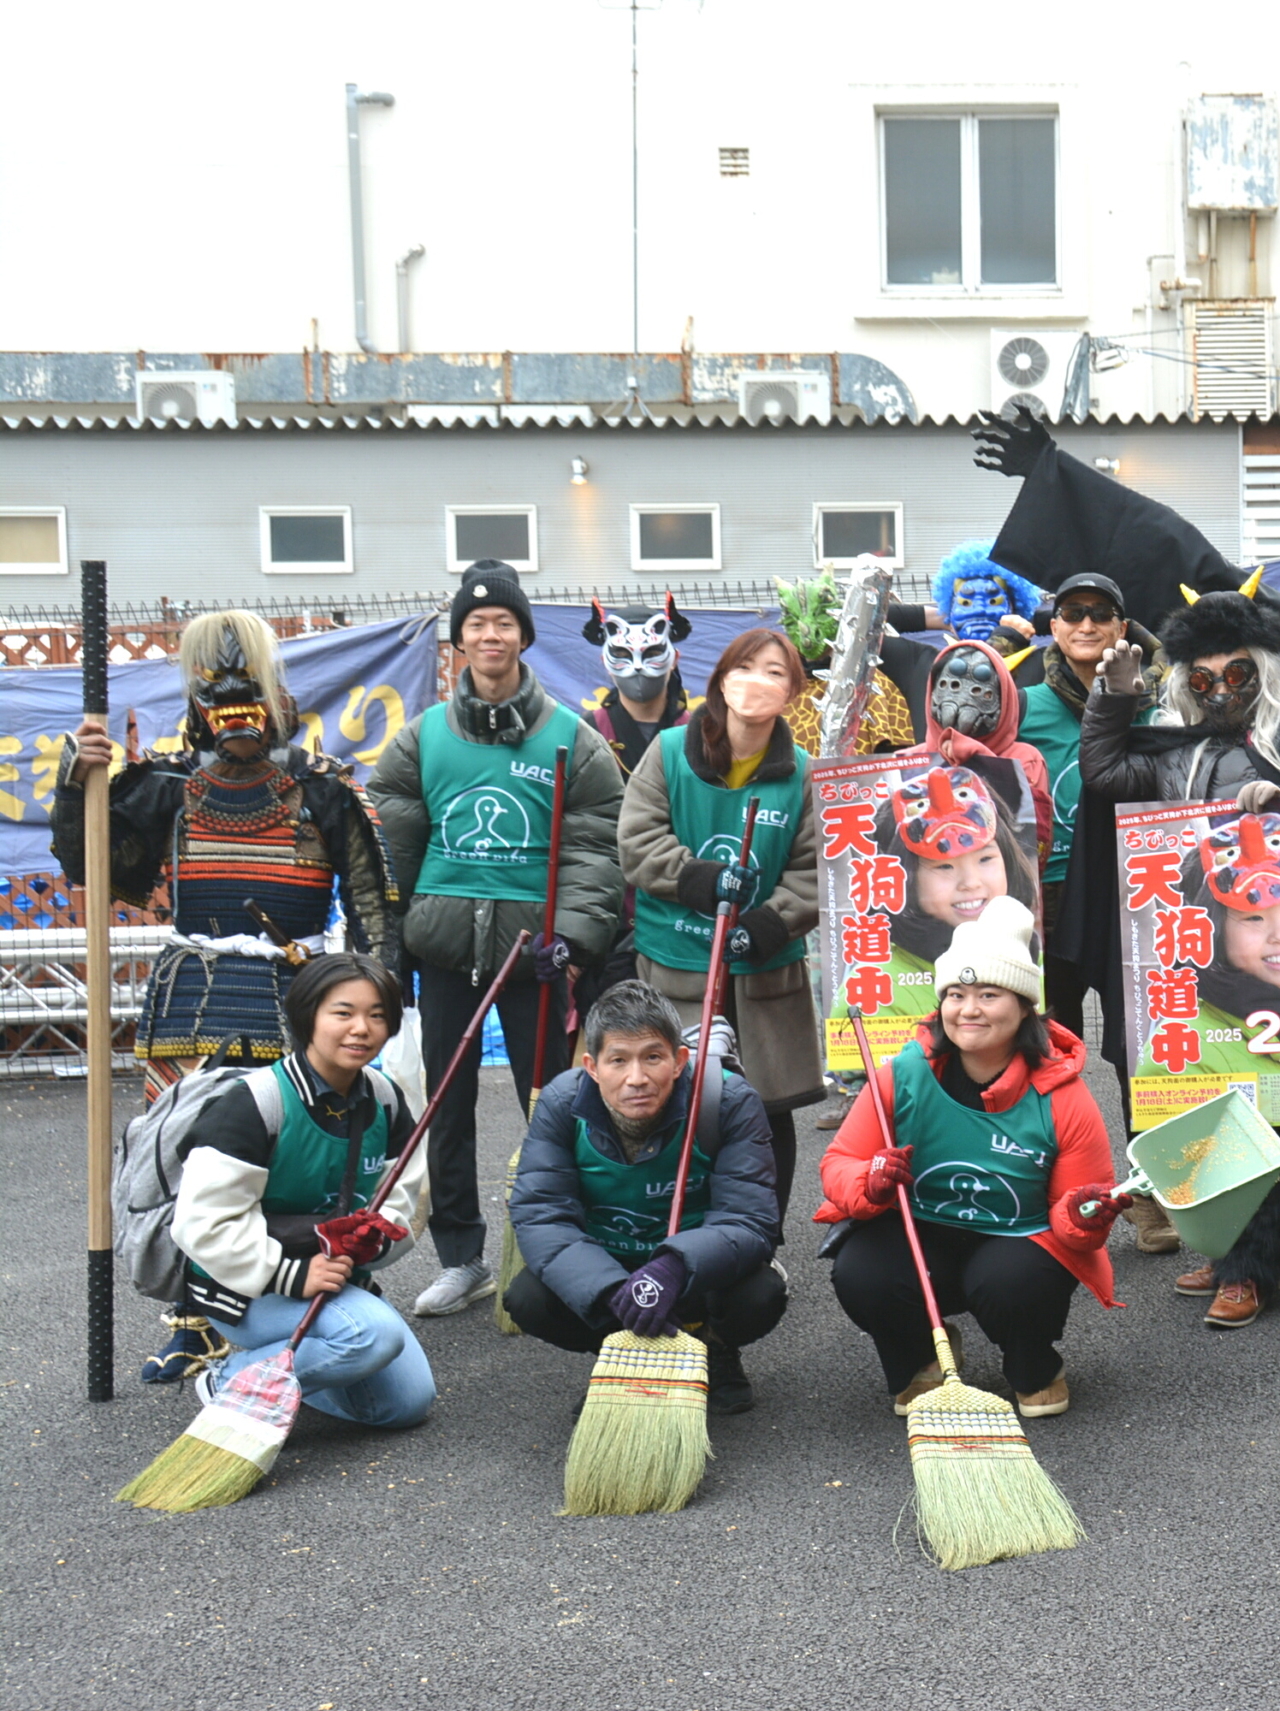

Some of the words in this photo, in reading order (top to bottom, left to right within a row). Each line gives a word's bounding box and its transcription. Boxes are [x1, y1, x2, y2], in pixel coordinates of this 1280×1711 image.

[820, 782, 890, 801] ちびっこ
[1124, 829, 1198, 849] ちびっこ
[820, 802, 907, 1015] 天狗道中
[675, 919, 714, 936] gree
[1124, 851, 1215, 1074] 天狗道中
[897, 972, 933, 986] 2025
[1205, 1028, 1242, 1043] 2025
